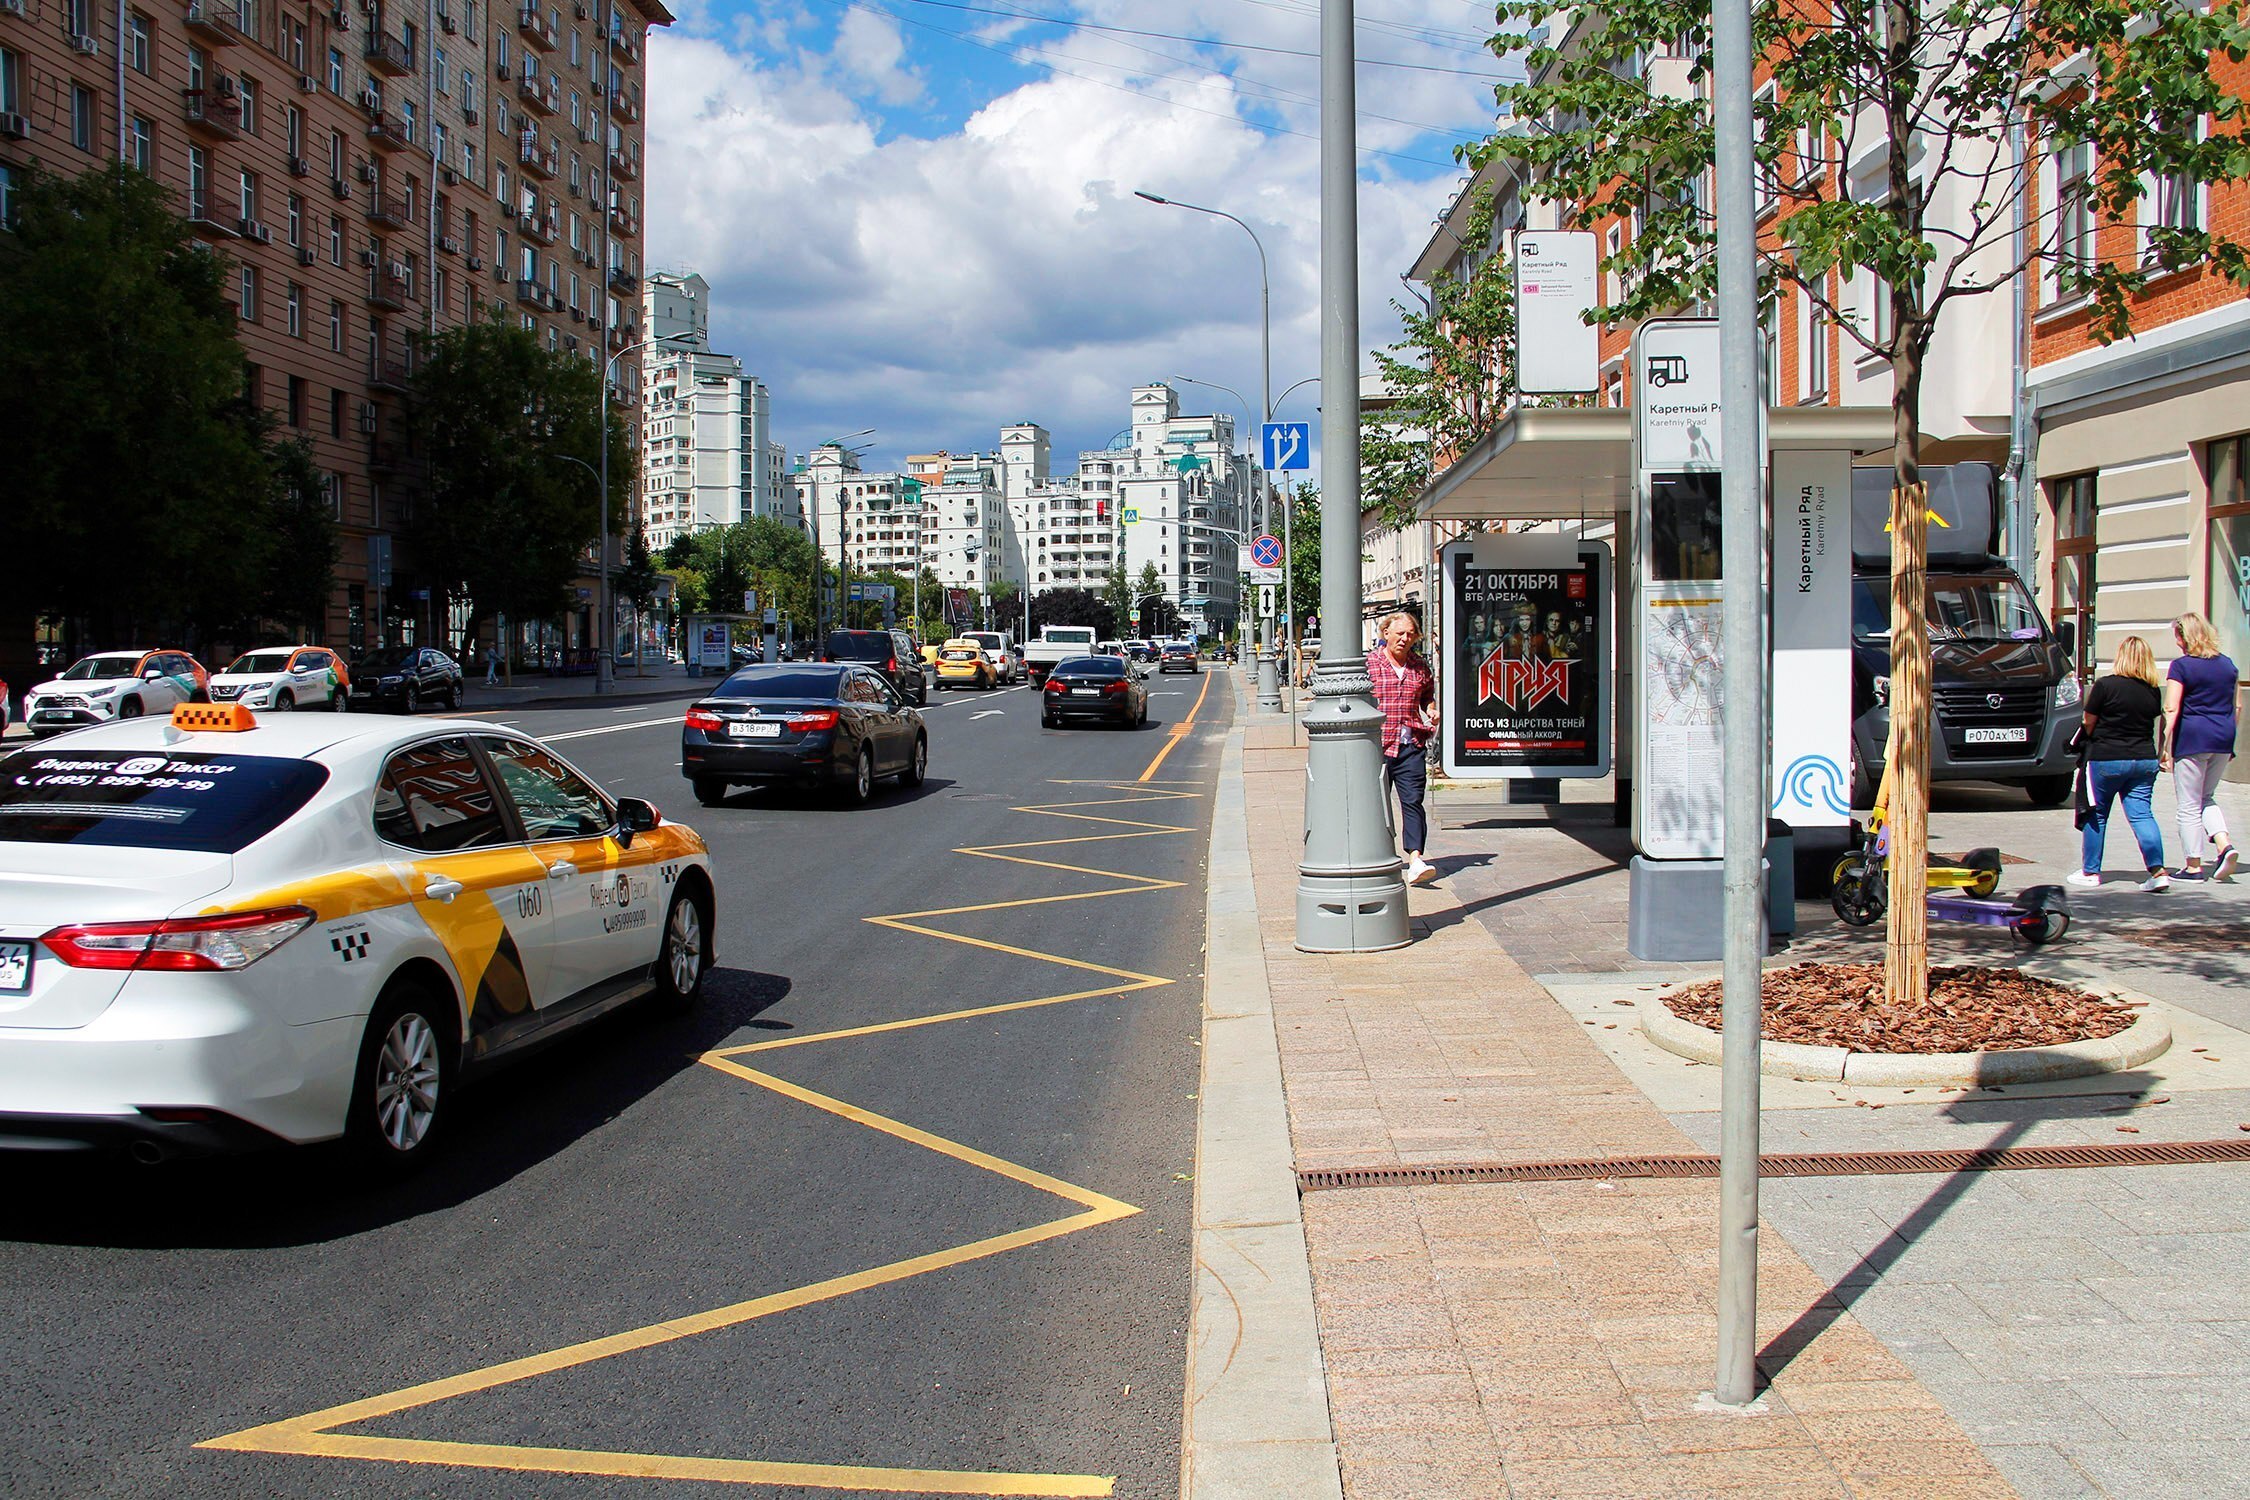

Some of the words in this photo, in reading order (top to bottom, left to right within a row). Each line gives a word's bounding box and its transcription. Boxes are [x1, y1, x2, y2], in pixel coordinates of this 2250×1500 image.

[1650, 404, 1708, 415] Каретный
[1650, 419, 1684, 427] Karetniy
[1687, 418, 1707, 427] Ryad
[1799, 486, 1813, 513] Ряд
[1816, 486, 1826, 511] Ryad
[1816, 514, 1826, 556] Karetniy
[1799, 518, 1813, 592] Каретный
[1465, 574, 1481, 590] 21
[1488, 574, 1558, 590] ОКТЯБРЯ
[1465, 592, 1484, 602] ВТБ
[1486, 592, 1528, 602] АРЕНА
[1465, 718, 1494, 729] ГОСТЬ
[1497, 718, 1509, 729] ИЗ
[1511, 718, 1554, 730] ЦАРСТВА
[1556, 716, 1585, 729] ТЕНЕЙ
[1489, 730, 1533, 739] ФИНАЛЬНЫЙ
[1534, 731, 1562, 740] АККОРД
[1969, 730, 2007, 741] Р070АХ
[31, 758, 119, 772] Яндекс
[165, 761, 237, 774] Такси
[35, 775, 97, 787] (495)
[98, 775, 215, 791] 999-99-99
[518, 886, 541, 918] 060
[590, 884, 616, 910] Яндекс
